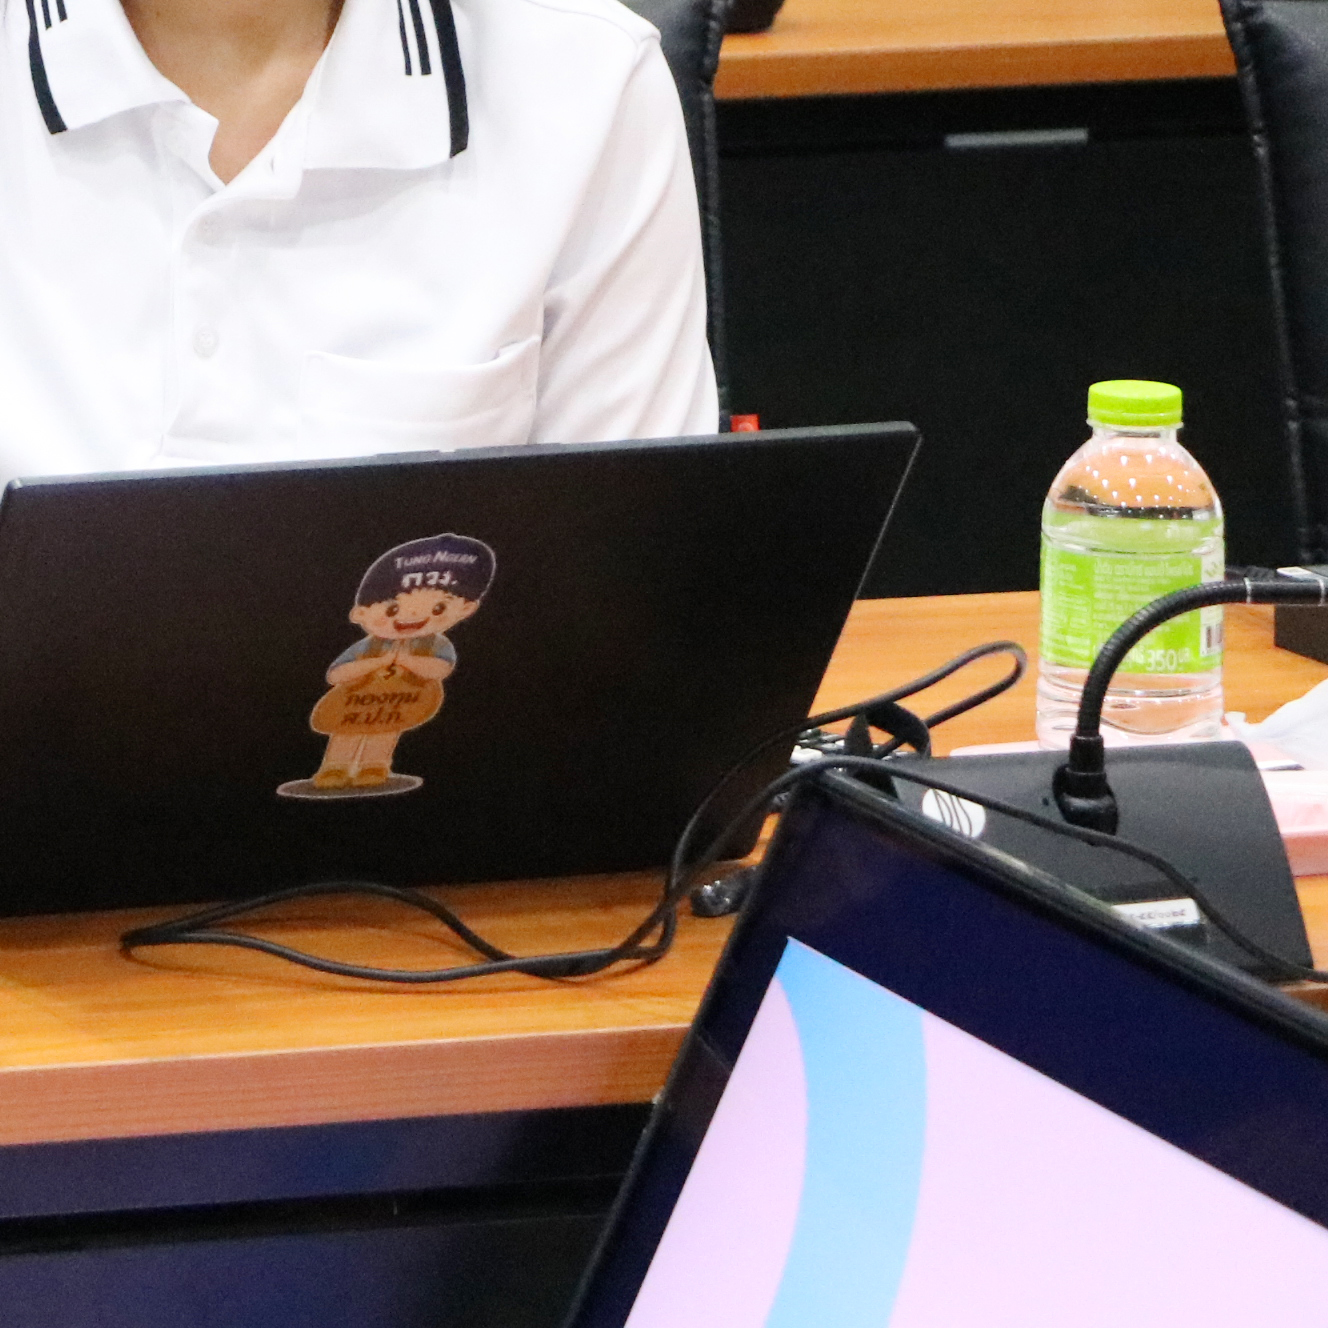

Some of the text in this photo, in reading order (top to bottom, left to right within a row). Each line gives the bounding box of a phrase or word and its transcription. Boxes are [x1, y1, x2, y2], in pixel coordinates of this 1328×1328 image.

[1146, 650, 1177, 671] 350
[344, 691, 421, 709] กองทุน
